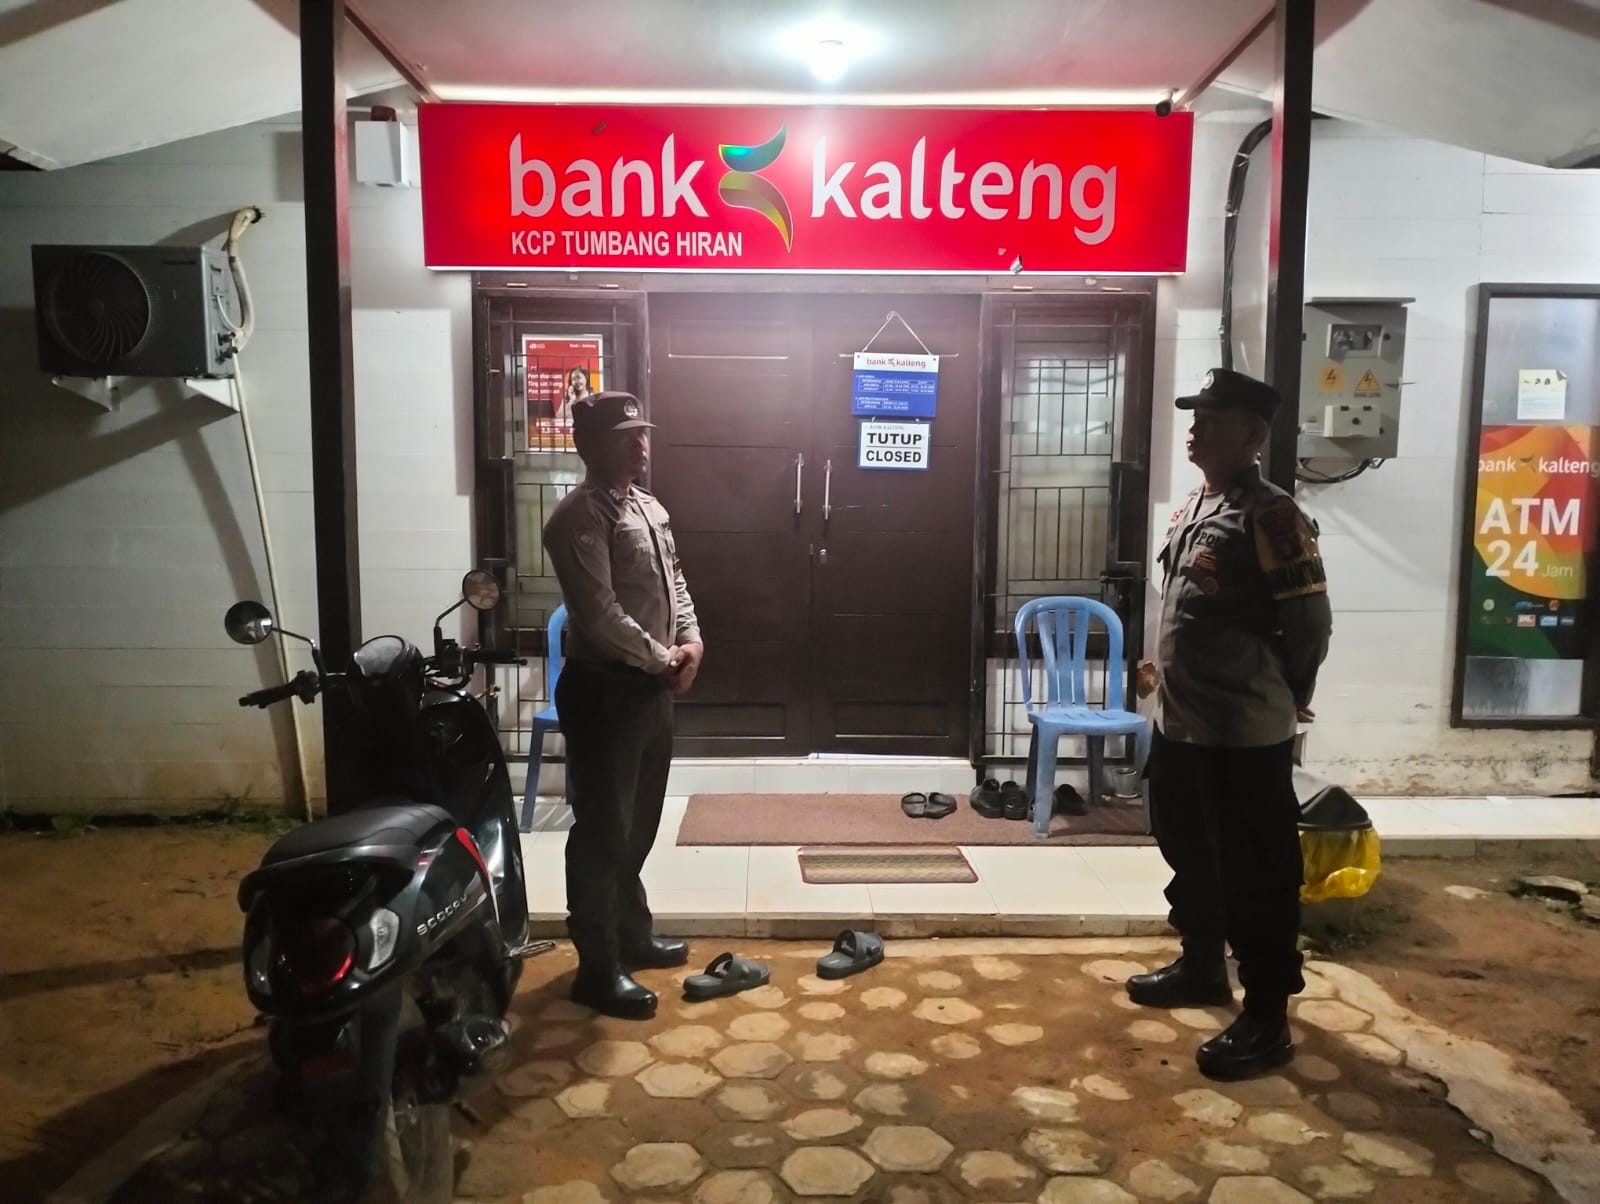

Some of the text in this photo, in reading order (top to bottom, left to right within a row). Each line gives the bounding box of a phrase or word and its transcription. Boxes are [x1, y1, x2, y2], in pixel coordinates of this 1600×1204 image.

[509, 132, 1118, 246] bank kalteng
[511, 231, 743, 258] KCP TUMBANG HIRAN
[866, 358, 926, 368] bank kalteng
[866, 432, 922, 445] TUTUP
[866, 450, 922, 463] CLOSED
[1539, 456, 1600, 478] kalteng
[1479, 498, 1581, 537] ATM
[1485, 540, 1573, 578] 24 Jam
